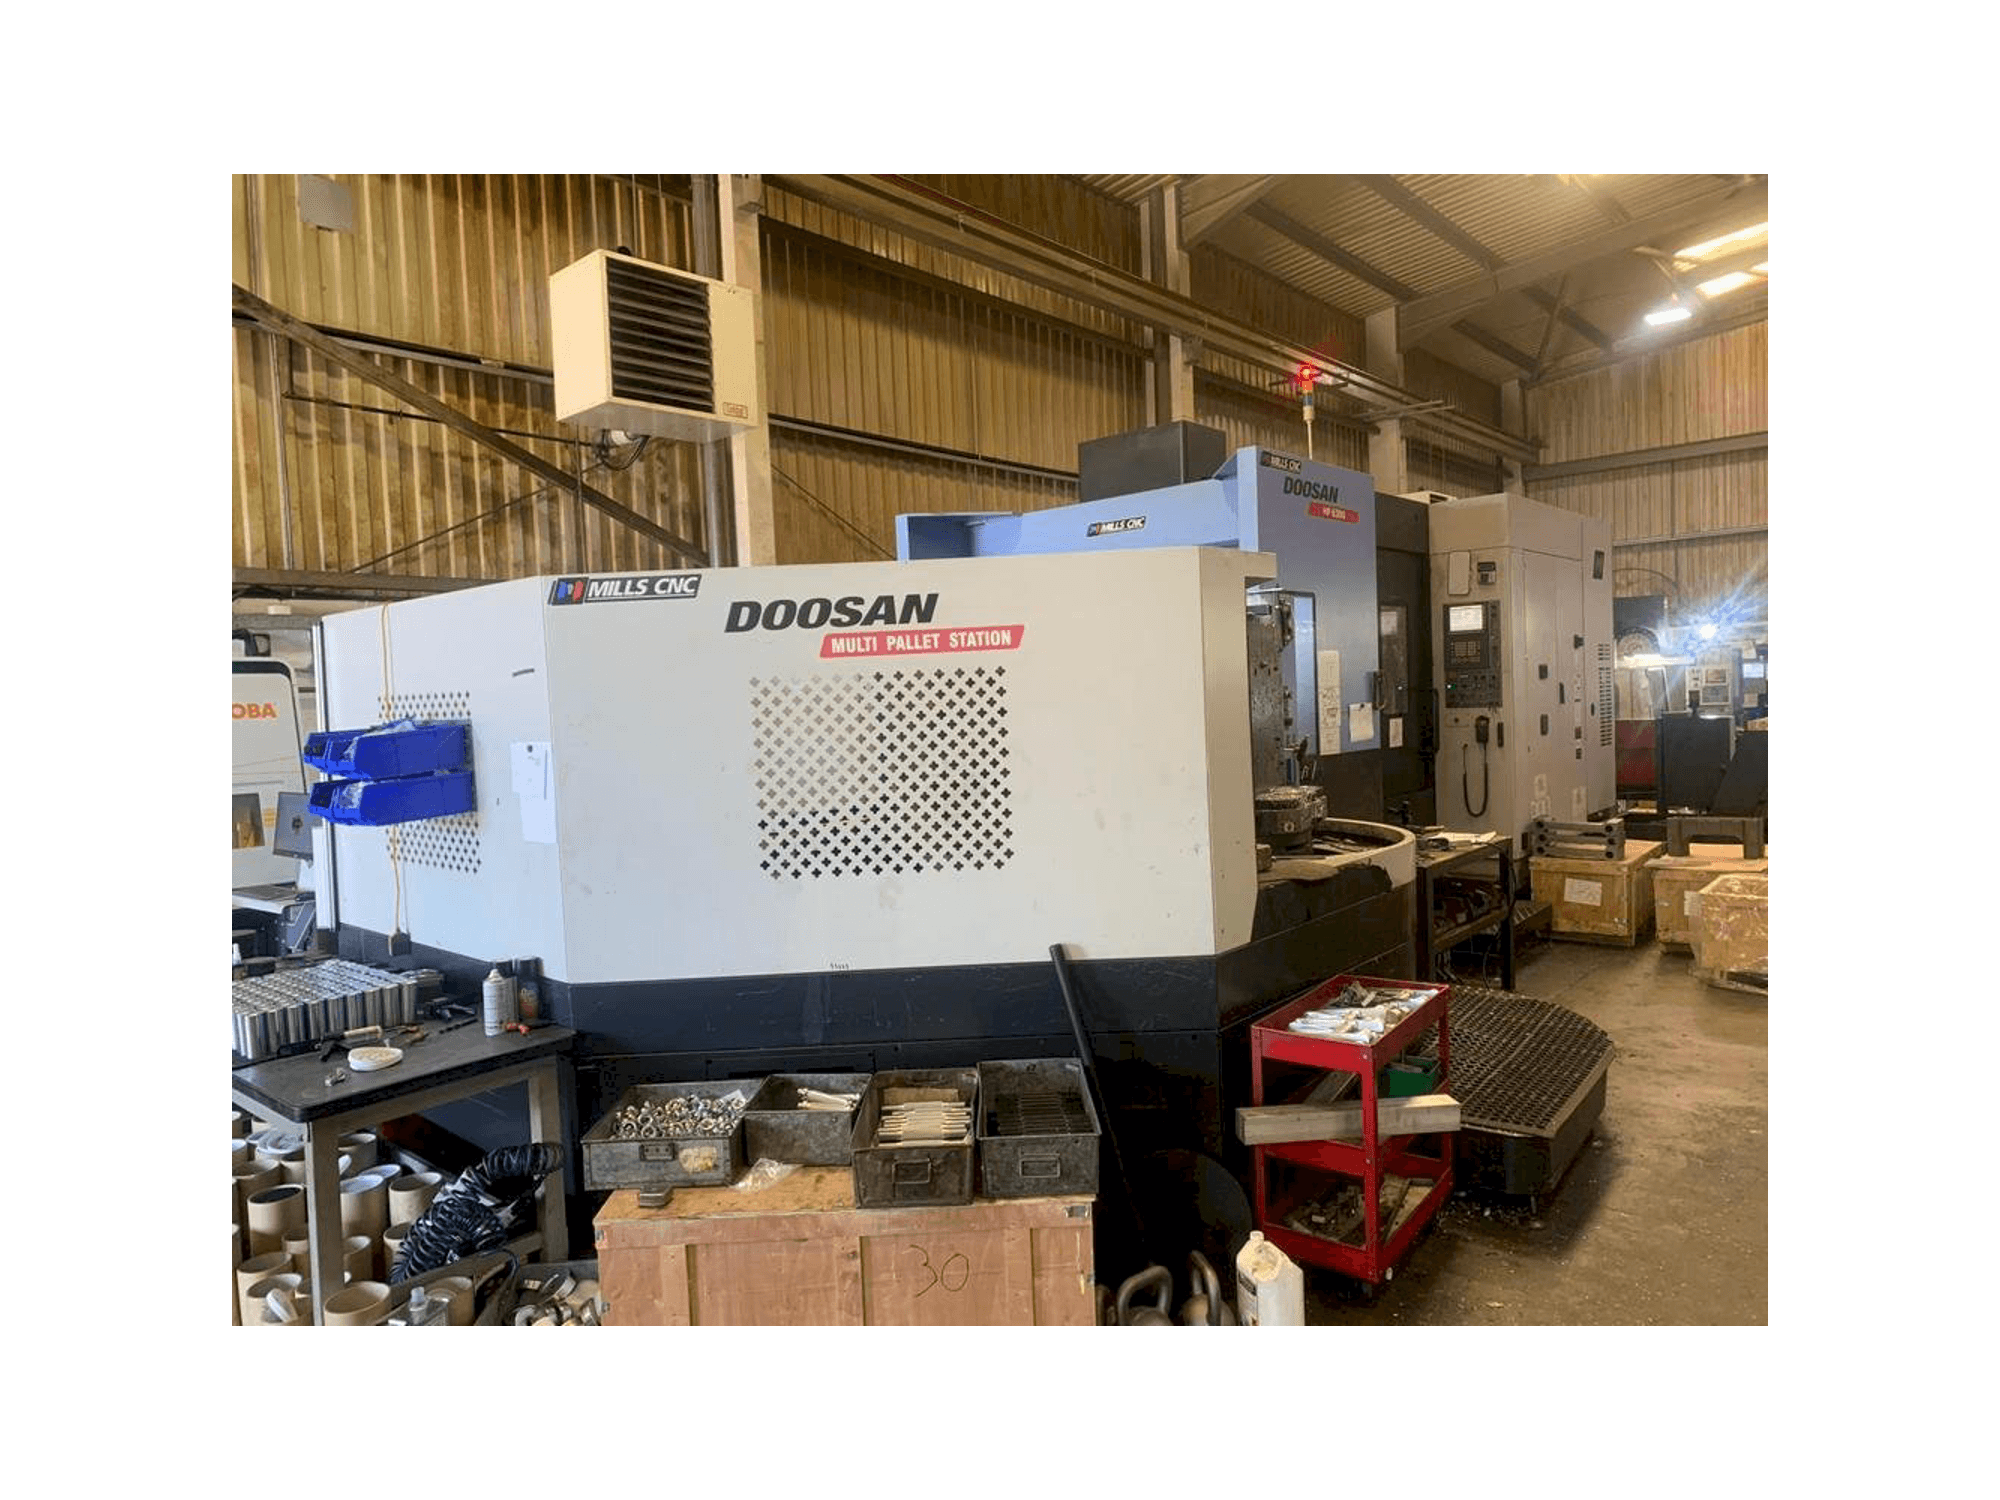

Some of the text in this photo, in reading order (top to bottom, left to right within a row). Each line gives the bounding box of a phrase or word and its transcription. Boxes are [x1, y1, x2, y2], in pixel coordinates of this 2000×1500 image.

[1283, 476, 1338, 503] DOOSAN
[587, 576, 699, 598] MILLS CNC
[724, 593, 939, 633] DOOSAN
[831, 628, 1013, 654] MULTI PALLET STATION
[909, 1244, 970, 1298] 30
